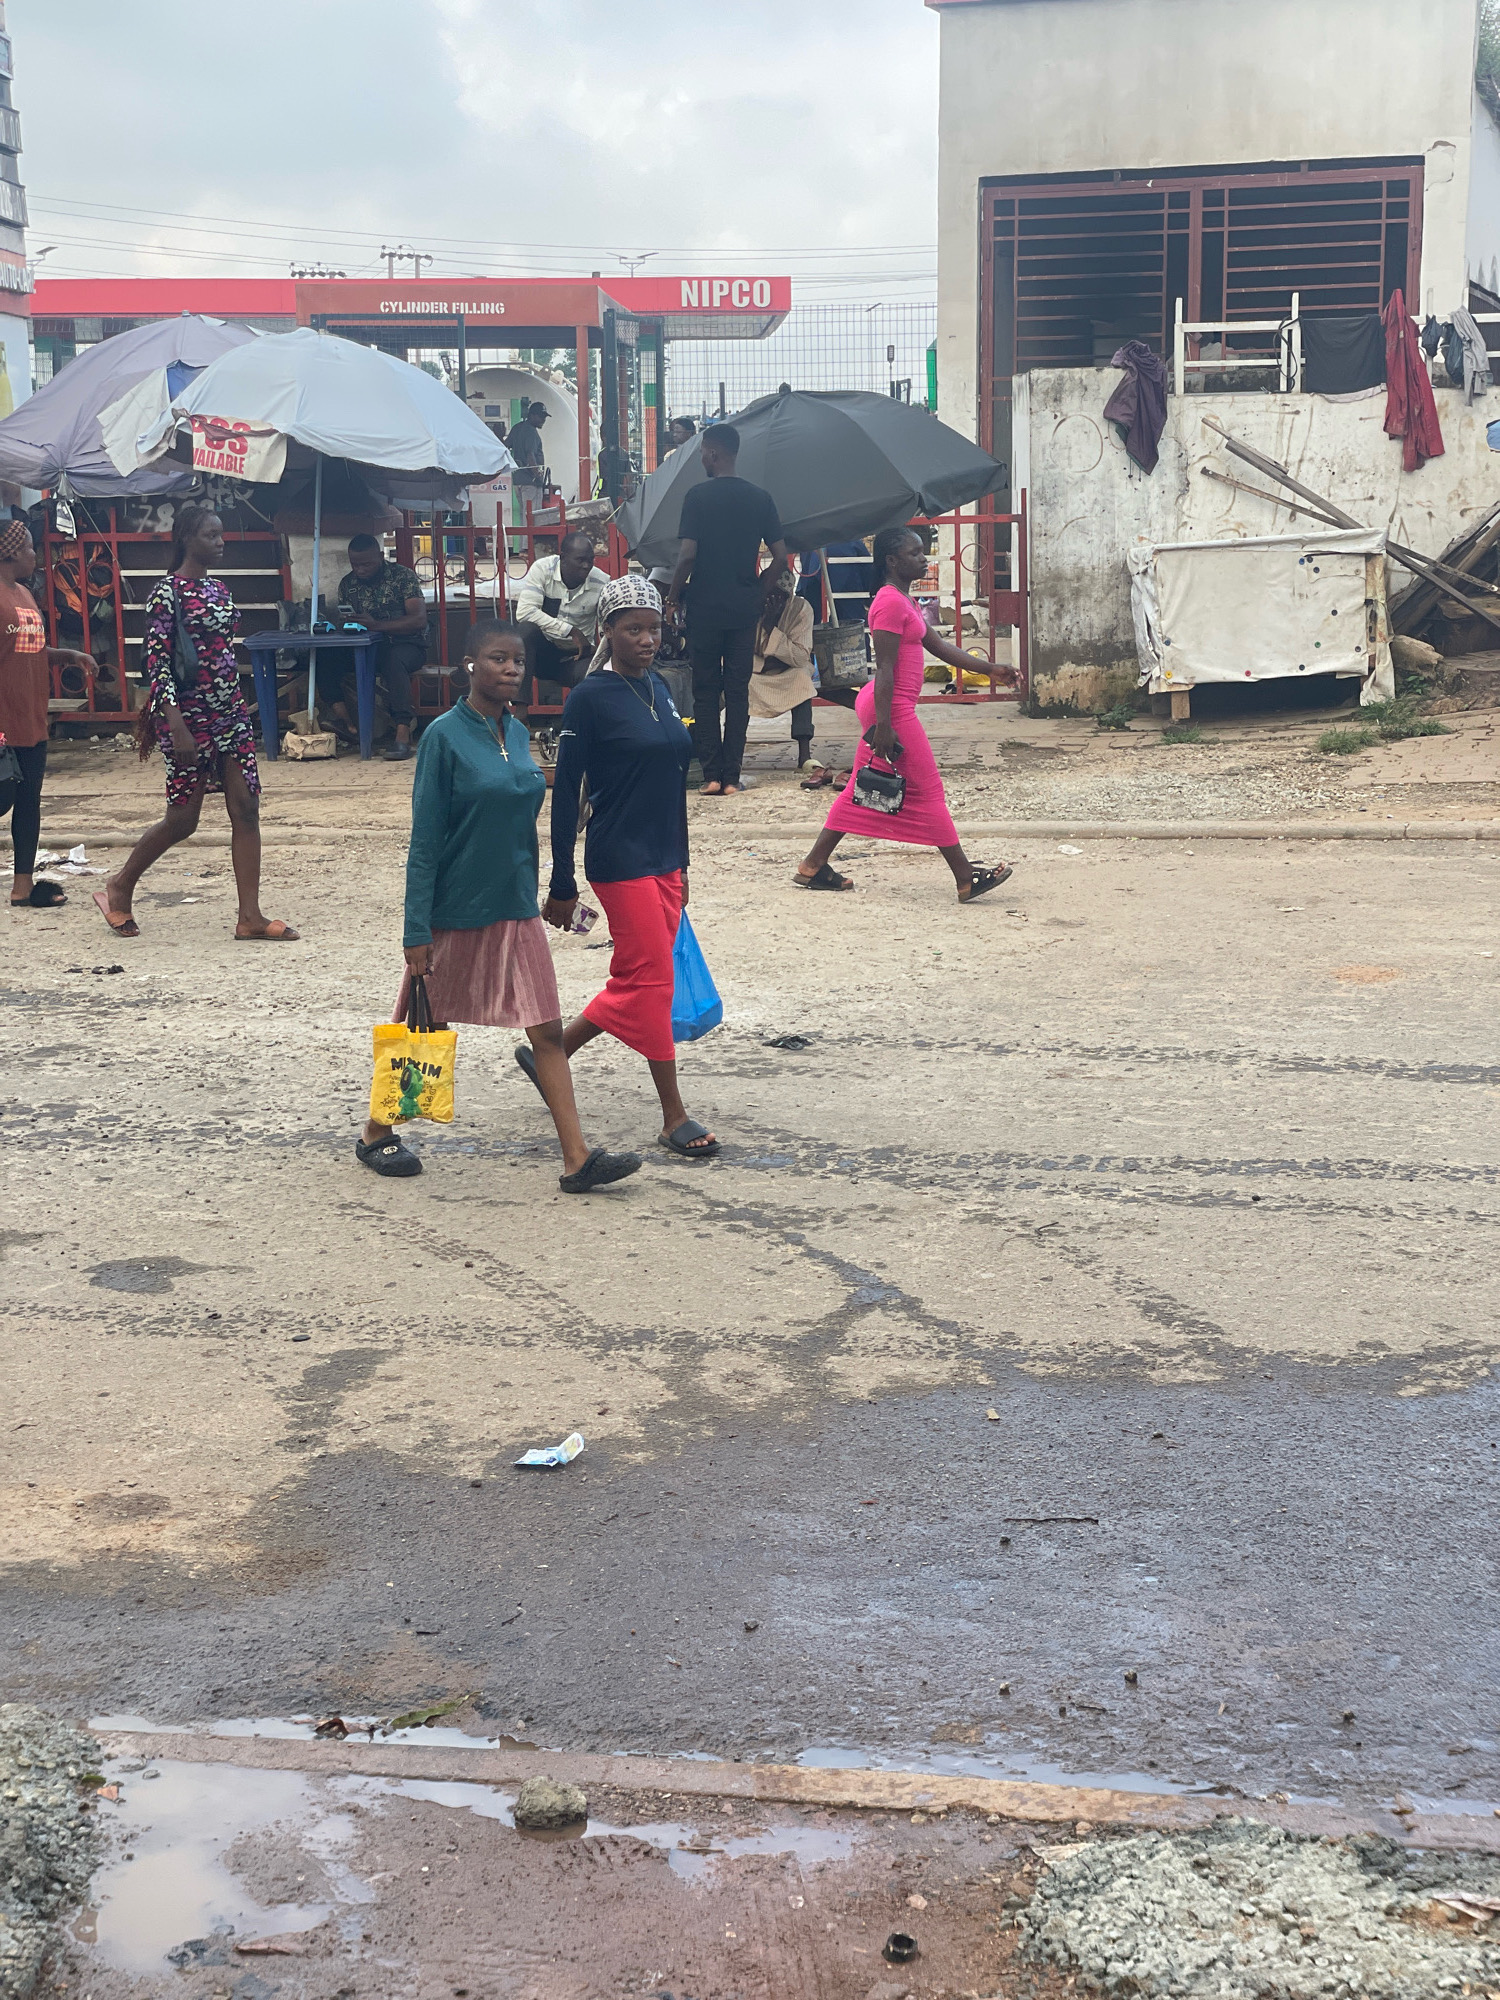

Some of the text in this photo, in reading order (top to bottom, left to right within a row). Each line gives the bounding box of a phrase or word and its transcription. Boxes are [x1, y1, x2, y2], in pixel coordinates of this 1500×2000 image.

[681, 279, 771, 308] NIPCO
[380, 301, 505, 314] CYLINDER FILLING
